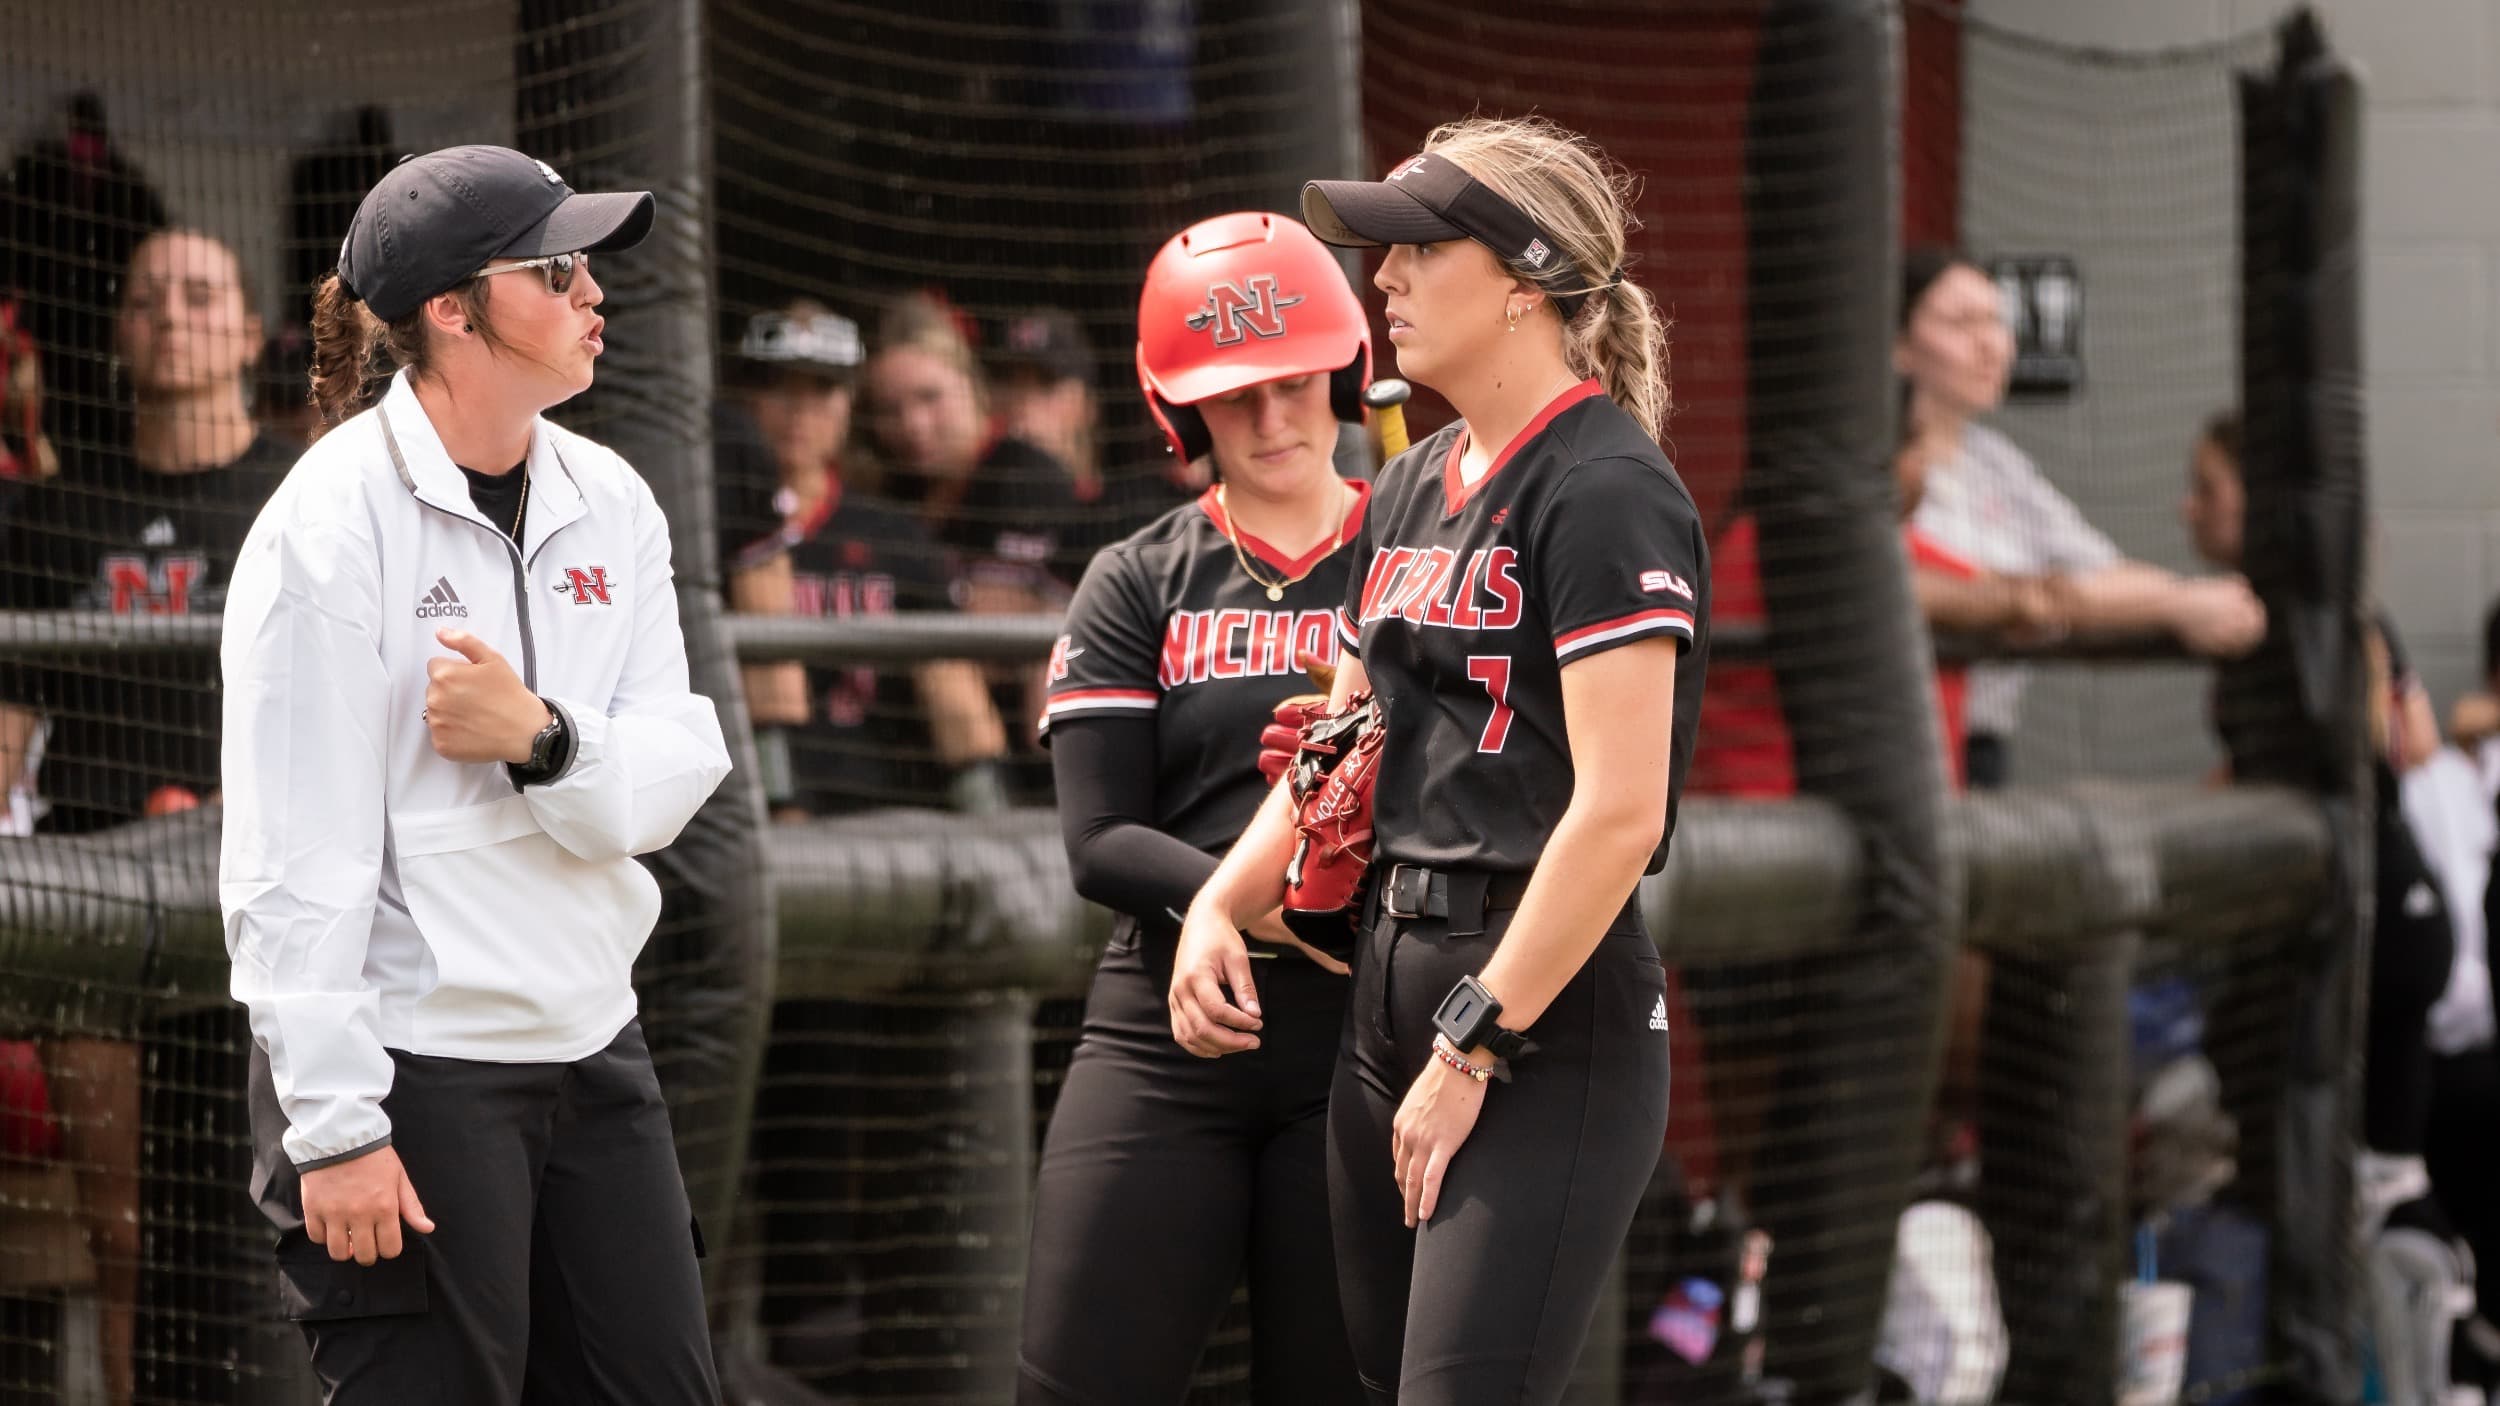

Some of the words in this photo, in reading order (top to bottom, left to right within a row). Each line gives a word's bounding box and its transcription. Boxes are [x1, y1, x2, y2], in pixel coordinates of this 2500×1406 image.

[1208, 274, 1285, 347] N
[415, 603, 468, 618] adidas
[565, 566, 612, 604] N
[1359, 545, 1523, 630] CHOLLS
[1157, 606, 1345, 691] NICHO
[1467, 656, 1514, 753] 7
